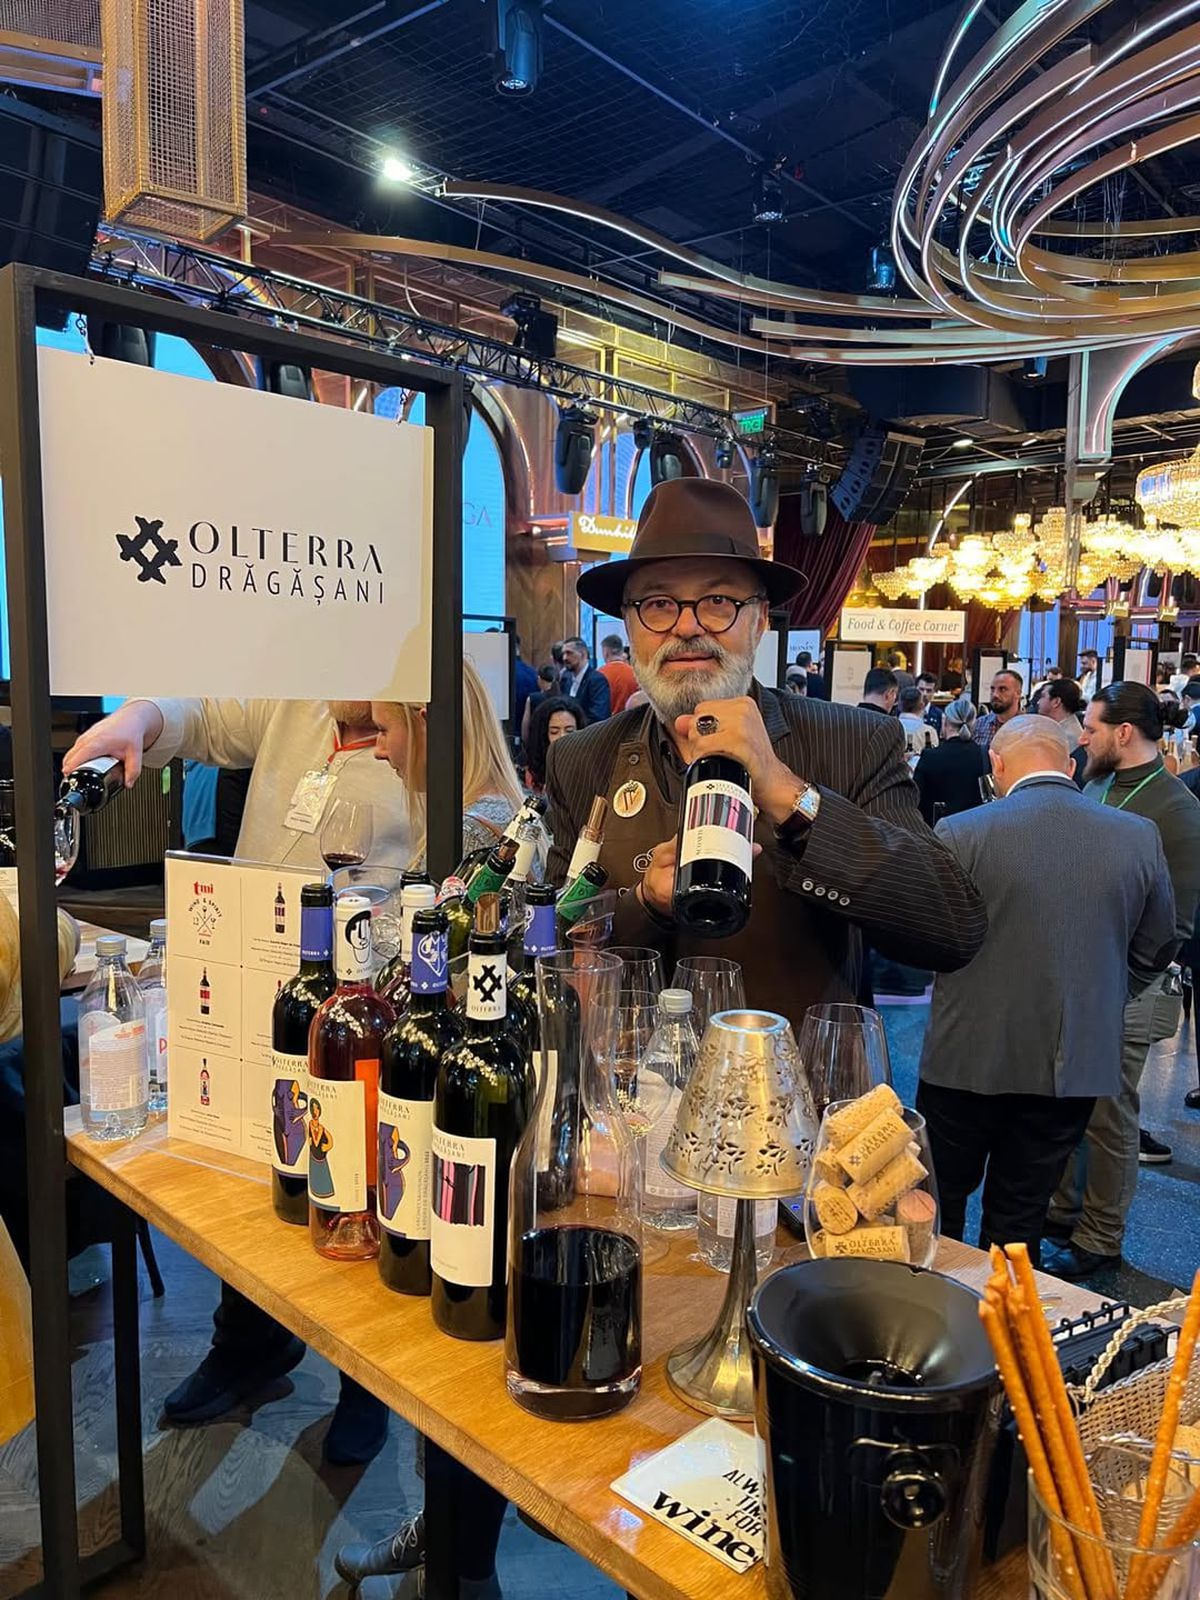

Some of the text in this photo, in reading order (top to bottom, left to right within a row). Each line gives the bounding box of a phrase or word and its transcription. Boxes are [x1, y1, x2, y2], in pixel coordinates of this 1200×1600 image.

[188, 520, 383, 574] OLTERRA
[191, 562, 383, 606] DRĂGĂȘANI
[847, 617, 960, 634] Food & Coffee Corner
[193, 880, 214, 895] tmi
[722, 1469, 760, 1498] ALW
[653, 1490, 756, 1563] wine
[725, 1510, 762, 1536] FOR
